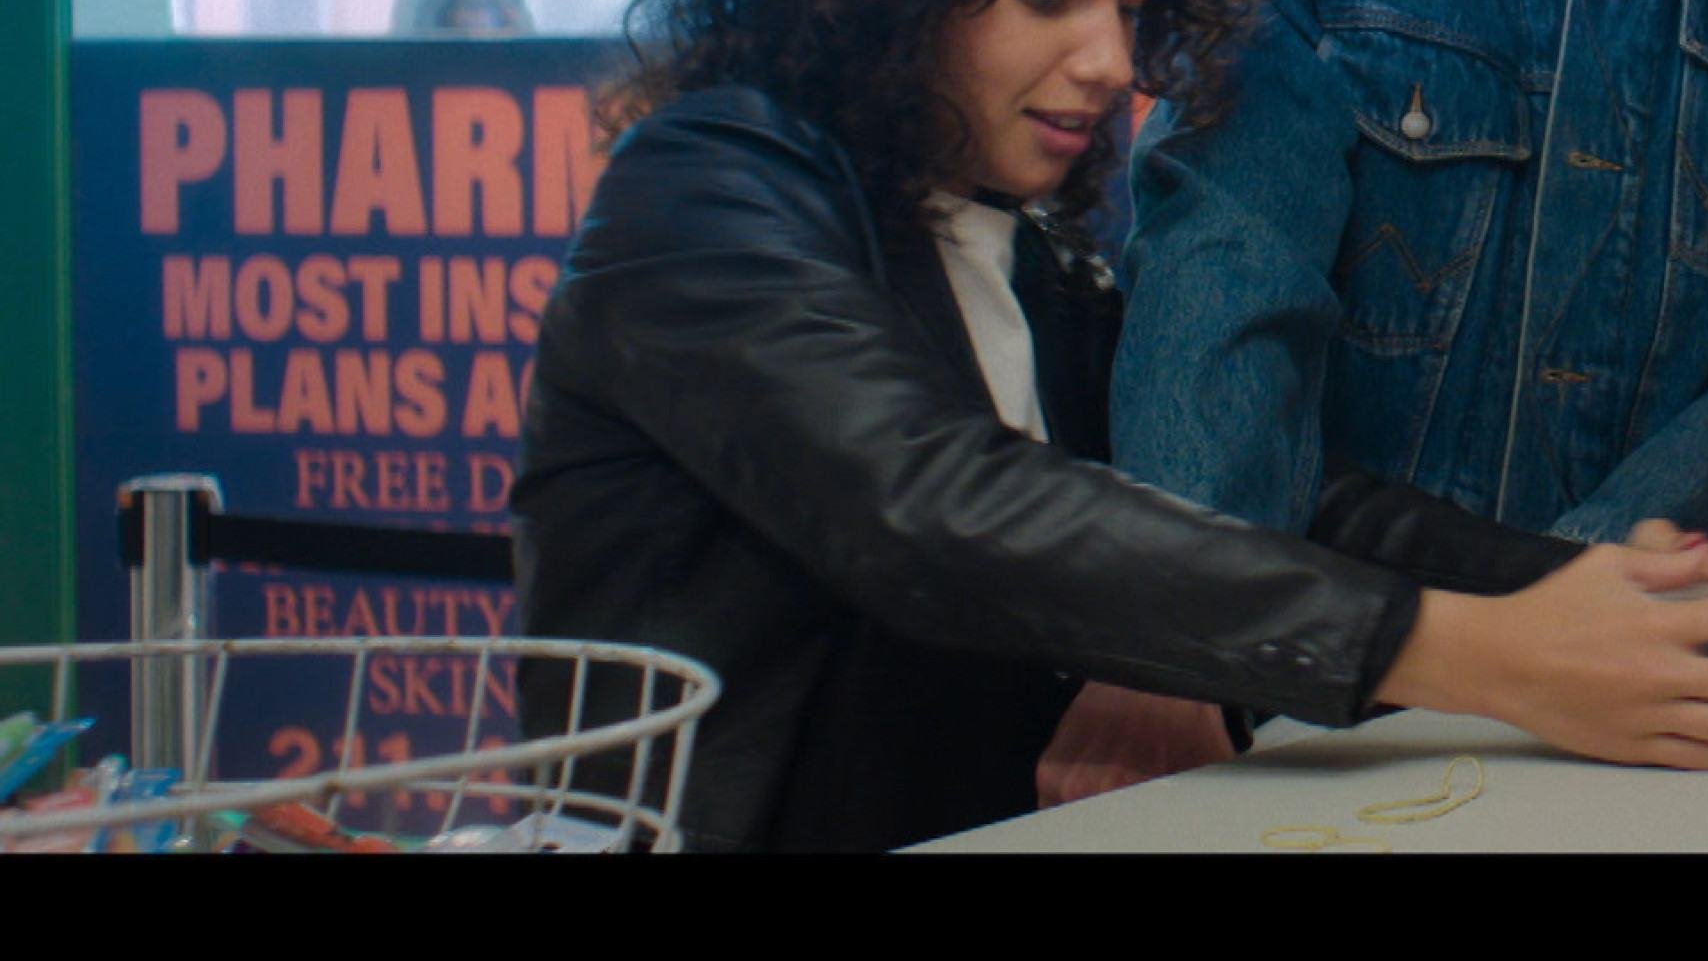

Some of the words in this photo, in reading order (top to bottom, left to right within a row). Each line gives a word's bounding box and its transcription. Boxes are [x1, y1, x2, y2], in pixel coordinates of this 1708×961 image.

[161, 254, 401, 342] MOST
[175, 347, 447, 438] PLANS
[294, 450, 450, 513] FREE
[263, 583, 516, 640] BEAUTY
[368, 661, 518, 718] SKIN
